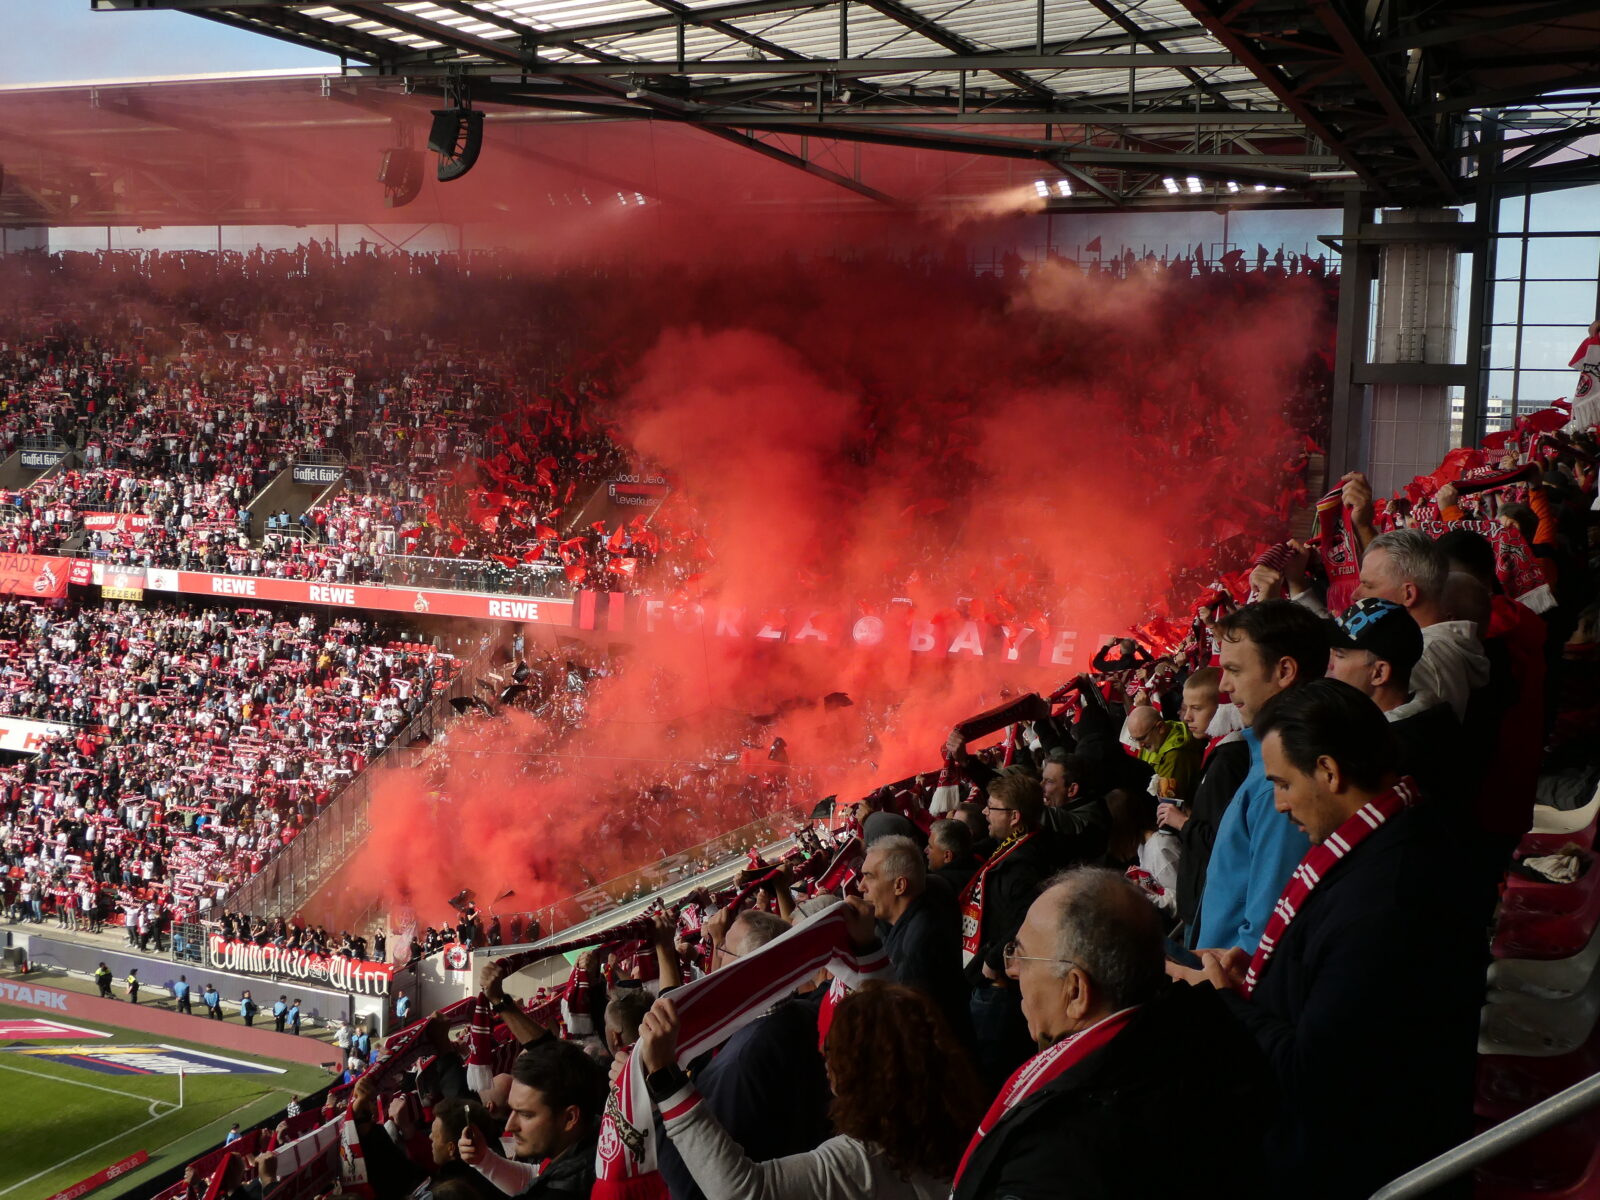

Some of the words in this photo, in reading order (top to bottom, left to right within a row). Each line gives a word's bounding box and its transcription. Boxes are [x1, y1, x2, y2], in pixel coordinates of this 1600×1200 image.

[293, 467, 318, 481] Gaffel
[107, 565, 142, 575] ALLEZ
[212, 577, 256, 596] REWE
[309, 585, 355, 605] REWE
[489, 600, 539, 620] REWE
